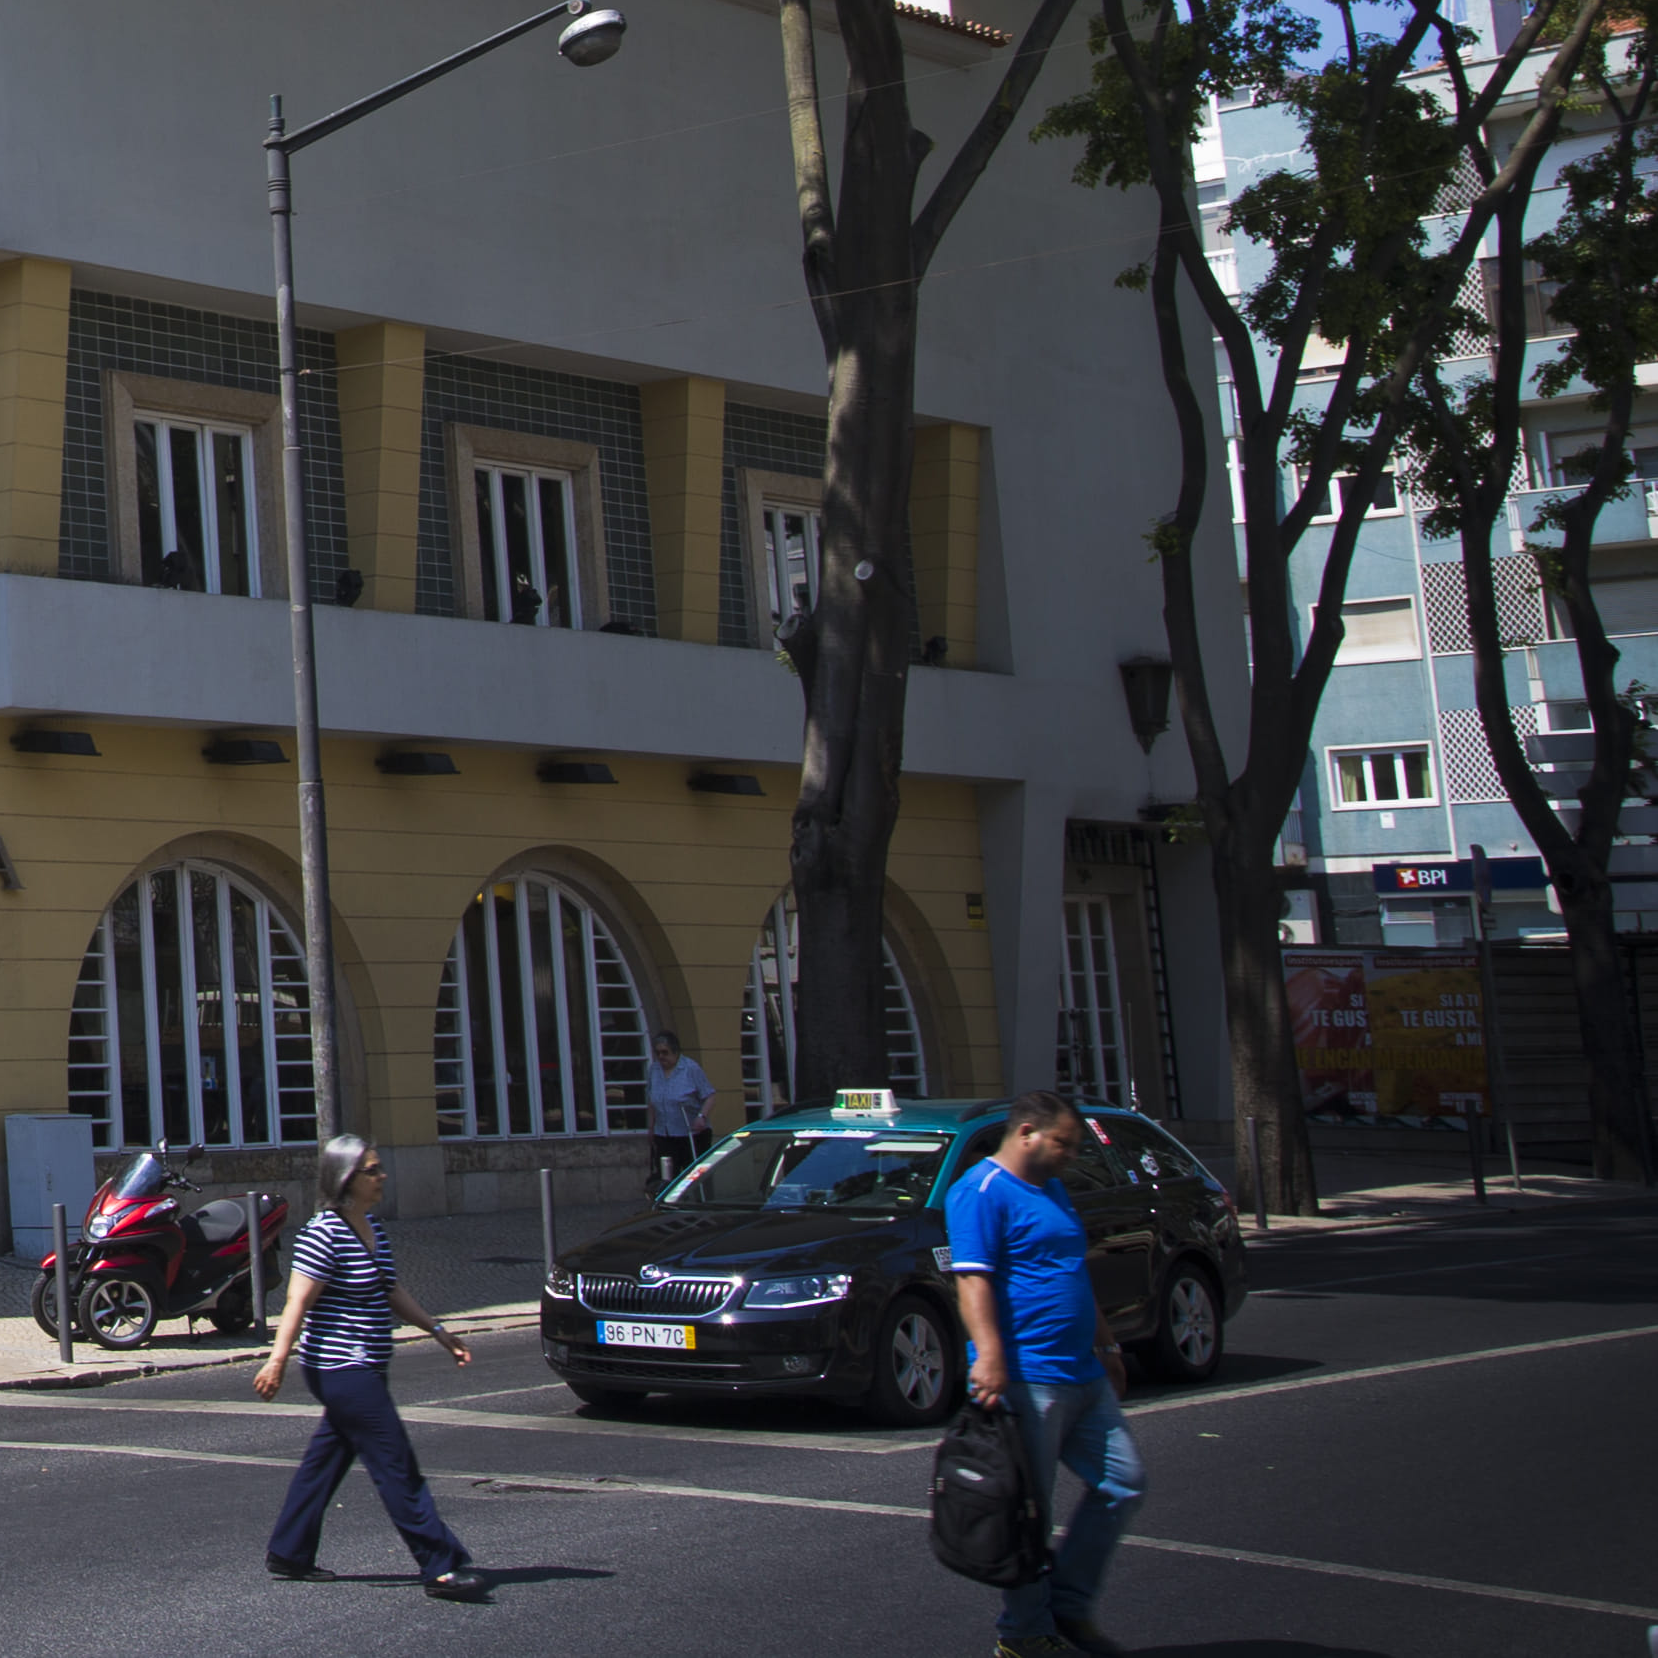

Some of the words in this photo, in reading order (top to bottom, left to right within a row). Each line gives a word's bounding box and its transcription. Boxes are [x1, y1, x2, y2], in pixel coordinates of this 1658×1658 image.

[1418, 869, 1448, 885] BPI
[1439, 993, 1453, 1007] SI
[1455, 993, 1465, 1007] A
[1466, 994, 1479, 1007] TI
[1400, 1009, 1421, 1027] TE
[1455, 1032, 1465, 1046] A
[847, 1093, 872, 1108] TAXI
